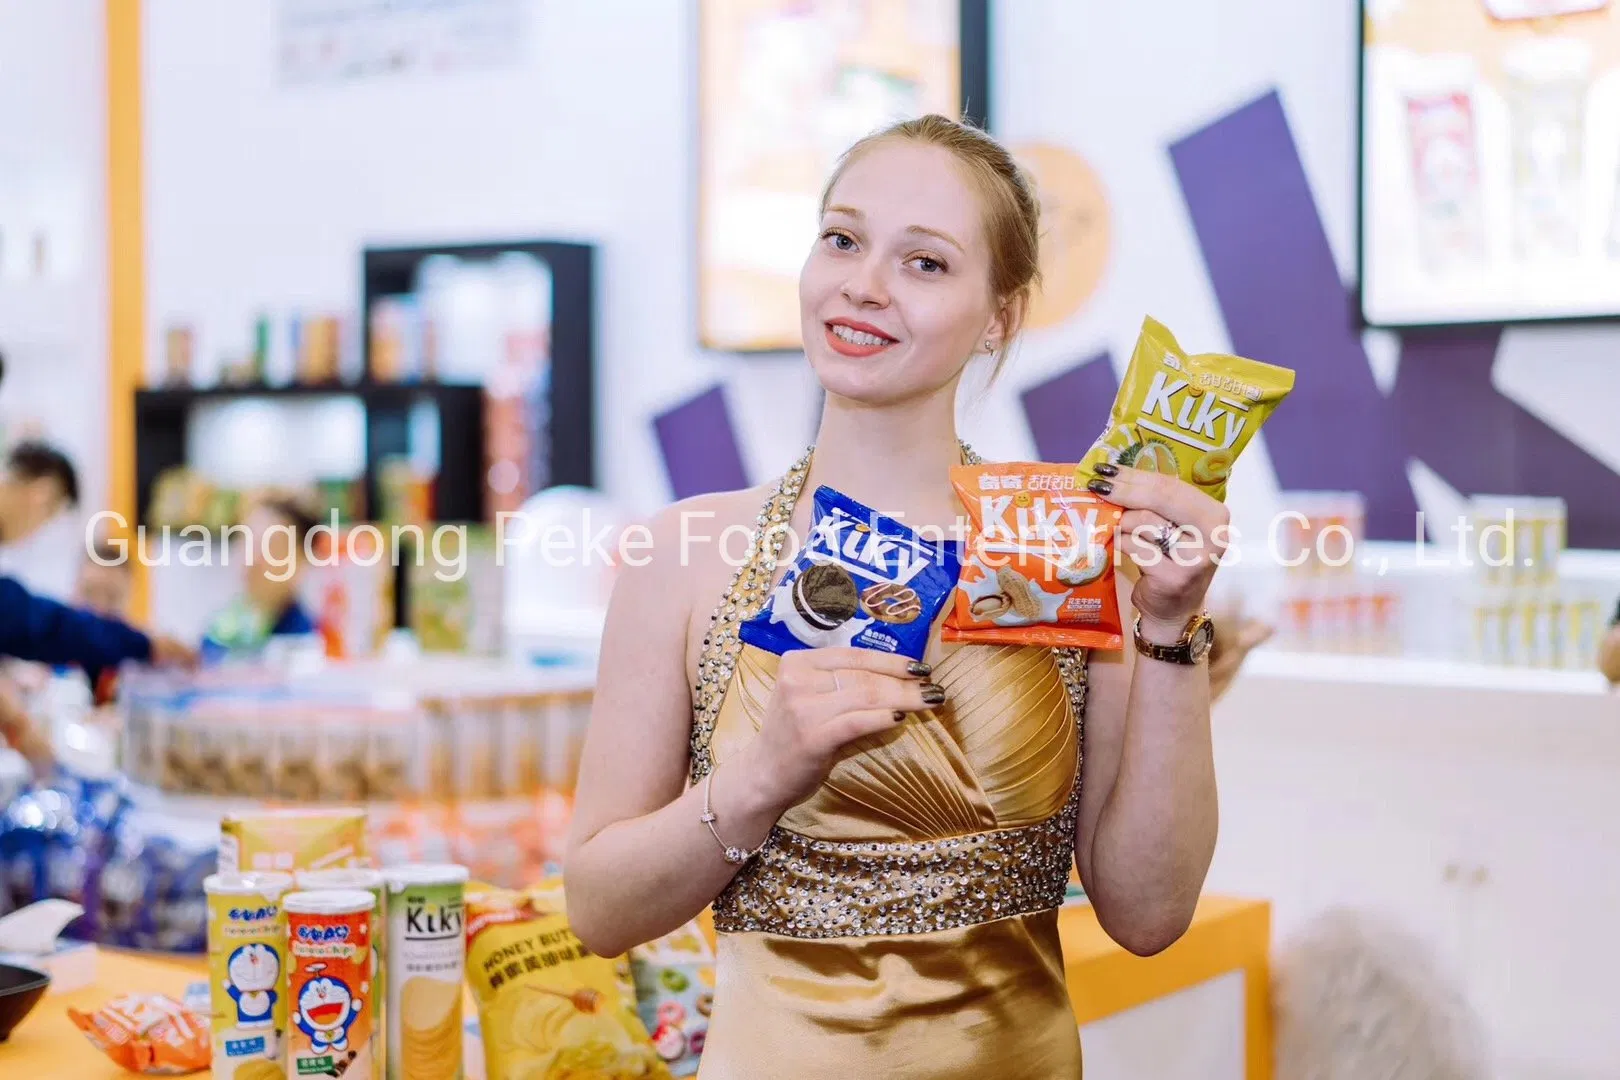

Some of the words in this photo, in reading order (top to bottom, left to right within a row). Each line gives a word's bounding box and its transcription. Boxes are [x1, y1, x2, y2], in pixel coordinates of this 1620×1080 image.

[1141, 371, 1247, 449] Kiky
[1028, 474, 1089, 491] 甜甜
[813, 516, 931, 584] Kiky
[980, 496, 1099, 552] Kiky
[483, 937, 534, 973] HONEY
[539, 928, 571, 947] BUT
